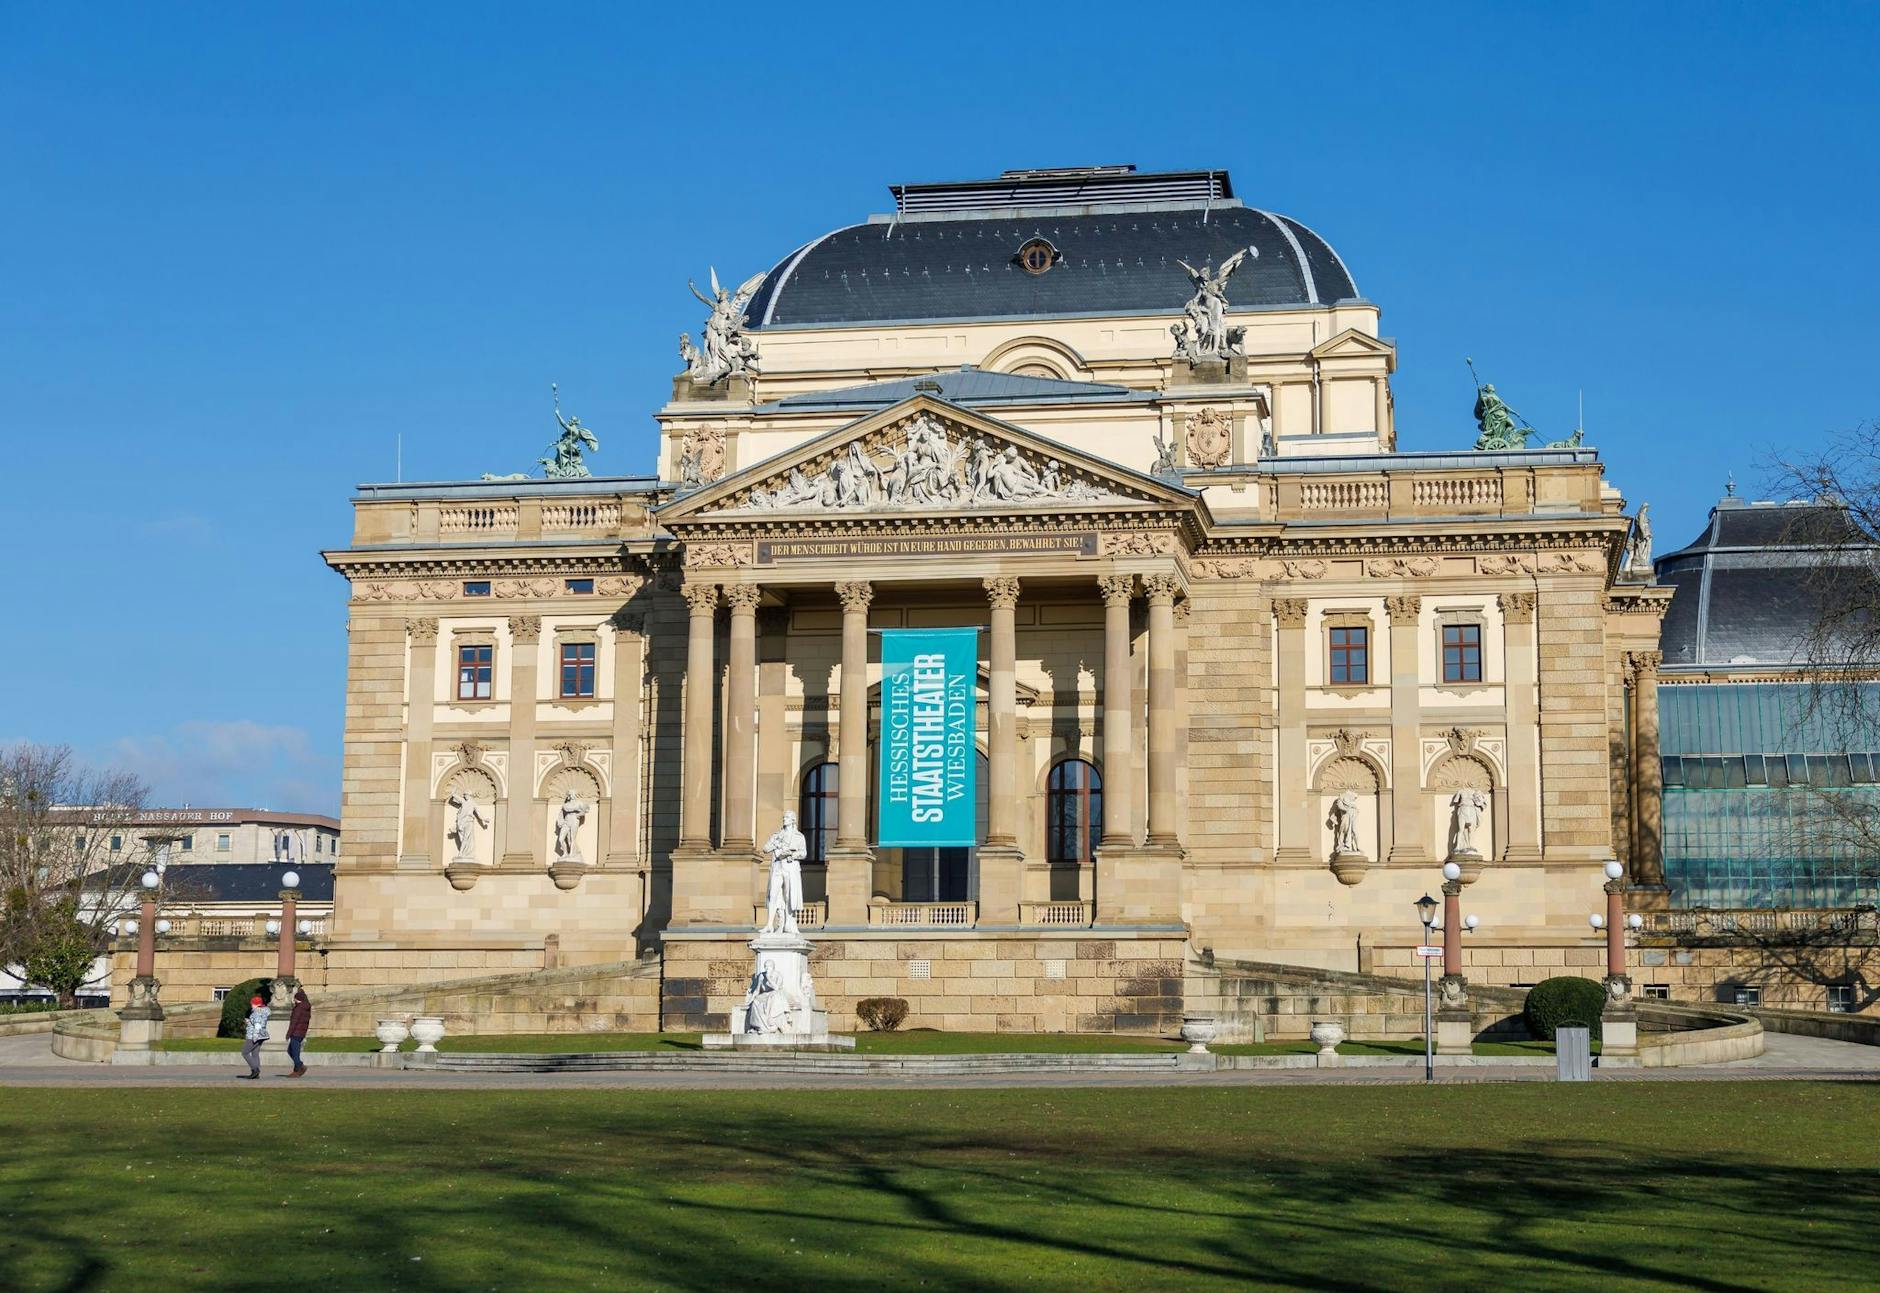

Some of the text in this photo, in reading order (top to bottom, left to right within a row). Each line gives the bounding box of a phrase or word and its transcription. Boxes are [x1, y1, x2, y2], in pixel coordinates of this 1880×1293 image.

[771, 537, 1083, 555] DER MENSCHHEIT WÜRDE IST IN EURE HAND GEGEBEN, BEWAHRET SIE!
[890, 672, 910, 803] HESSISCHES
[911, 653, 945, 823] STAATSTHEATER
[947, 673, 966, 802] WIESBADEN
[139, 812, 202, 821] NASSAUER
[209, 812, 233, 820] HOF
